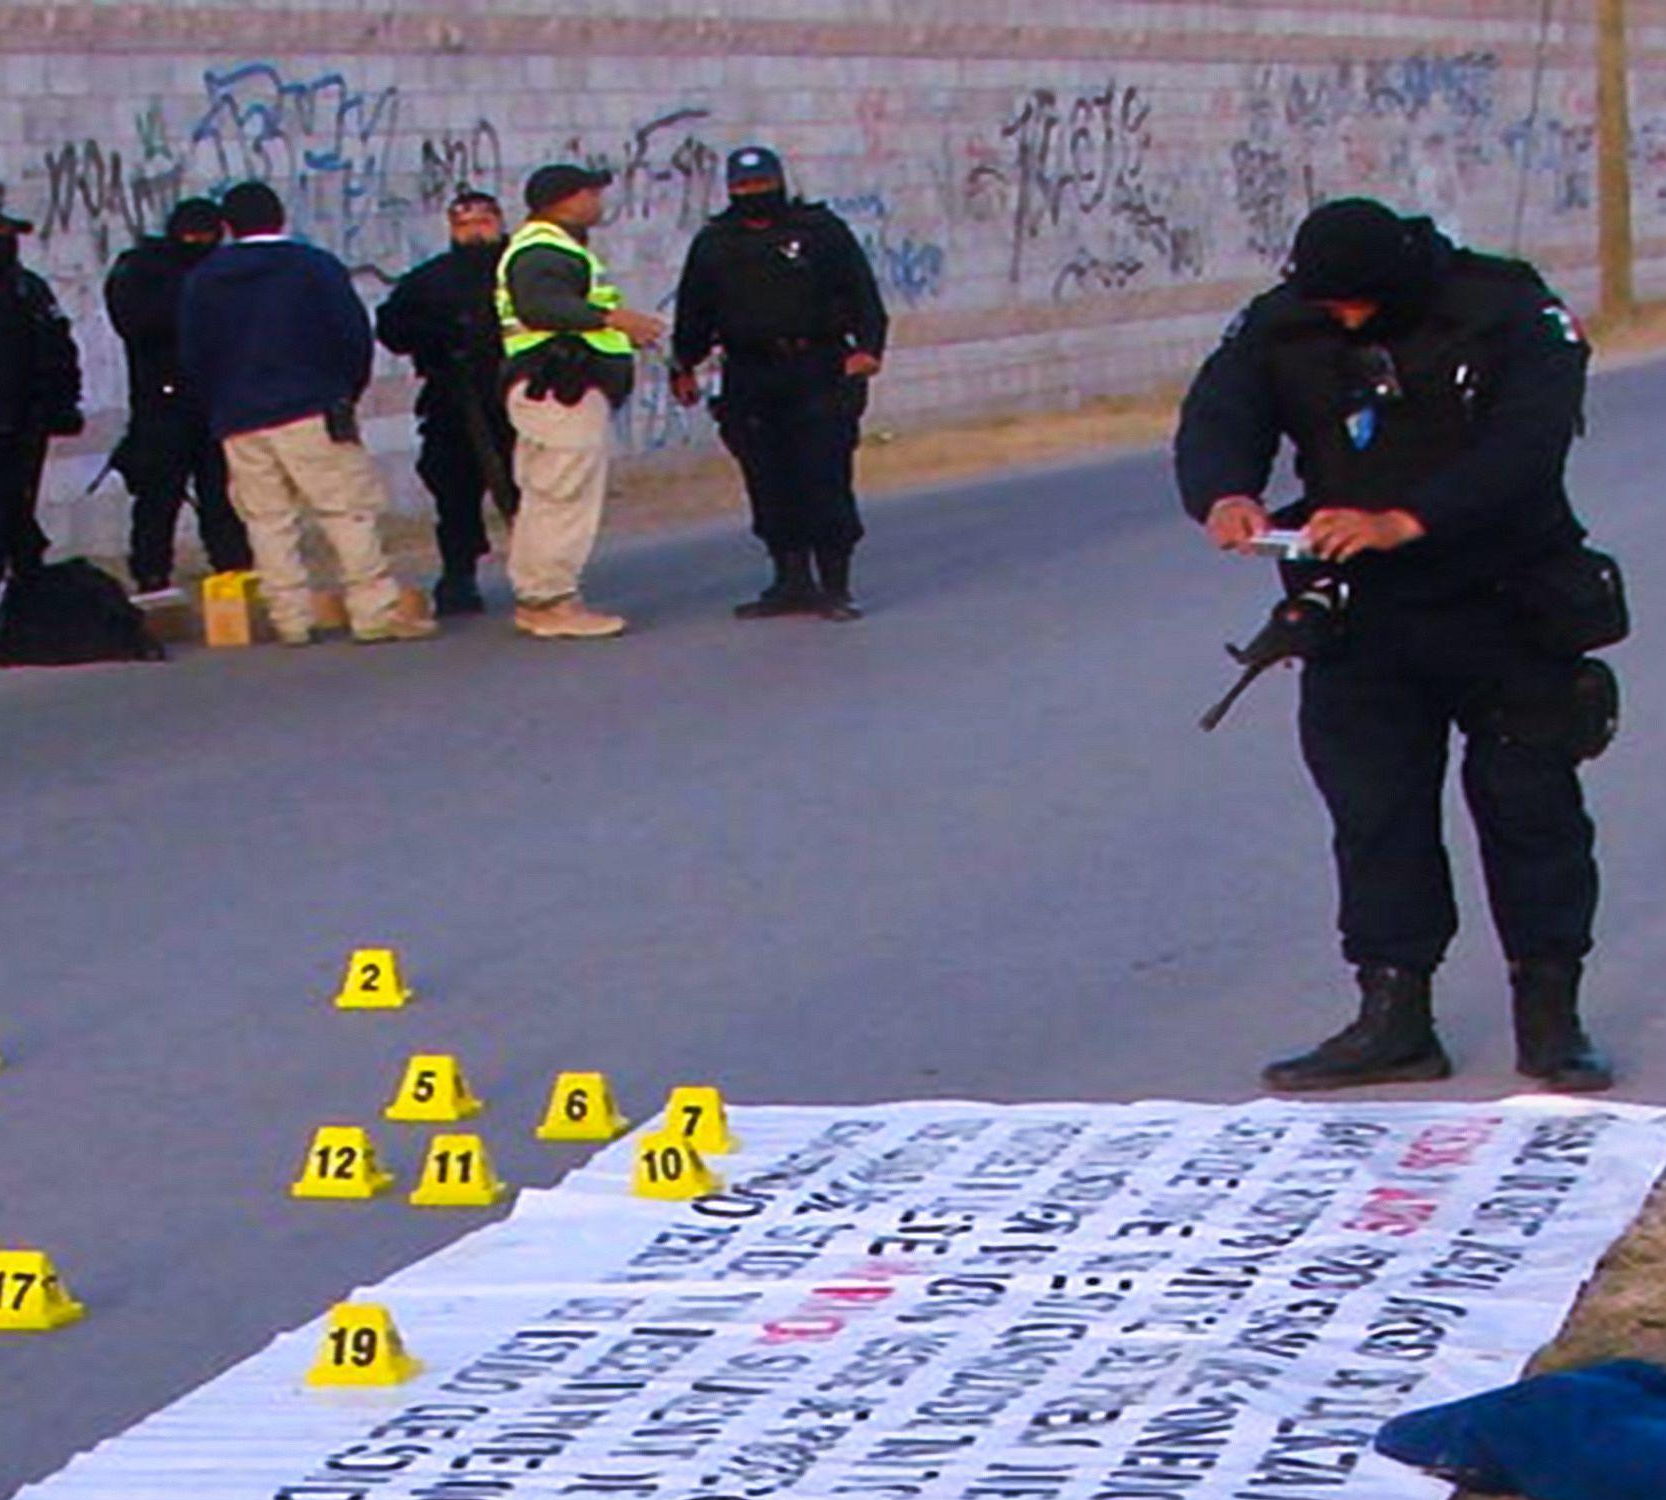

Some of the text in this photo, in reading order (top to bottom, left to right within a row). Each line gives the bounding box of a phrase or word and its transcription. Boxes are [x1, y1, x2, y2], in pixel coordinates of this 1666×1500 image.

[360, 962, 381, 992] 2
[412, 1070, 437, 1104] 5
[564, 1088, 588, 1123] 6
[681, 1105, 703, 1138] 7
[309, 1140, 358, 1181] 12
[434, 1150, 473, 1184] 11
[642, 1146, 683, 1183] 10
[329, 1326, 378, 1368] 19
